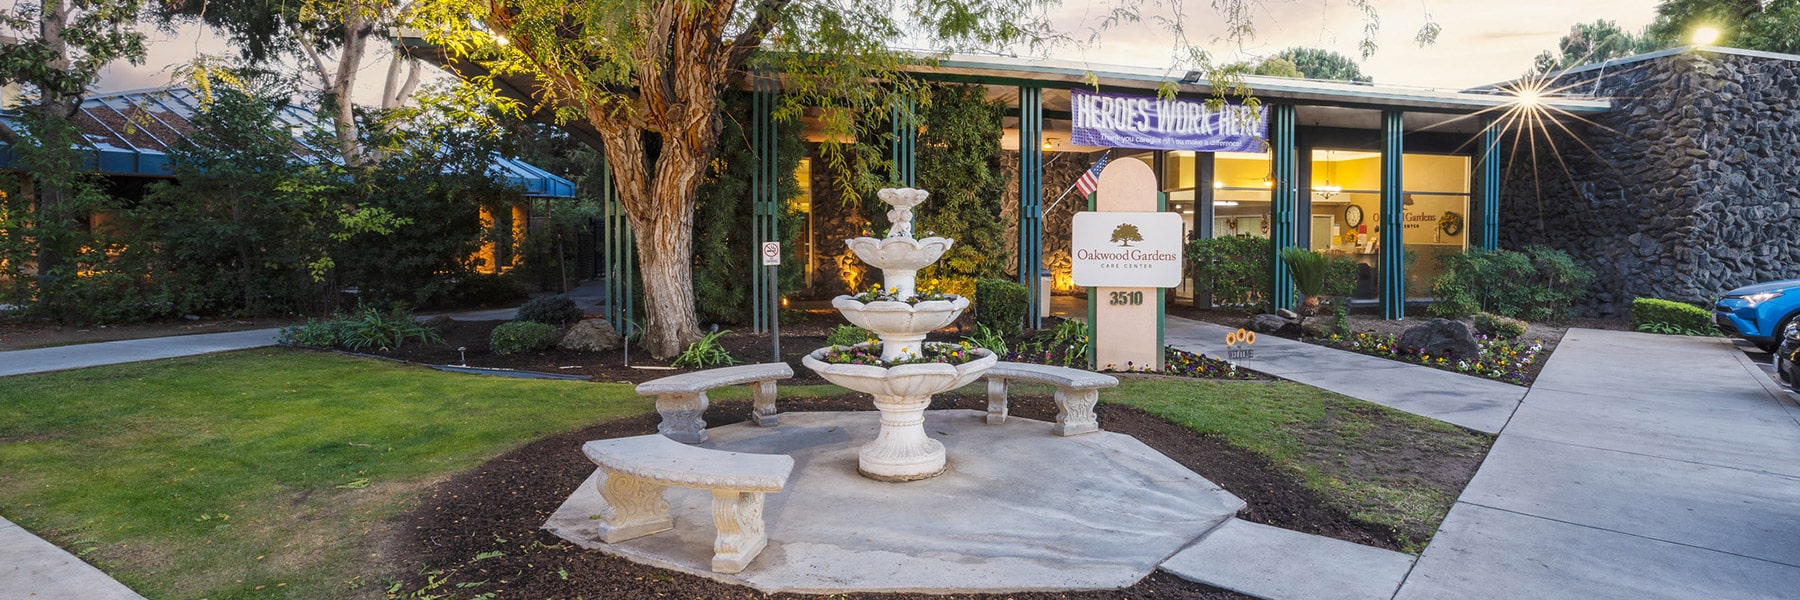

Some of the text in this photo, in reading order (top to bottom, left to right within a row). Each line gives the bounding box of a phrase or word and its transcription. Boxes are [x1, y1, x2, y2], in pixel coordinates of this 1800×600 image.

[1077, 93, 1150, 132] HEROES
[1156, 99, 1213, 134] WORK
[1101, 133, 1121, 142] Thank
[1122, 136, 1134, 144] you
[1405, 212, 1437, 222] Gardens
[1077, 249, 1177, 261] Oakwood Gardens
[1109, 291, 1143, 306] 3510
